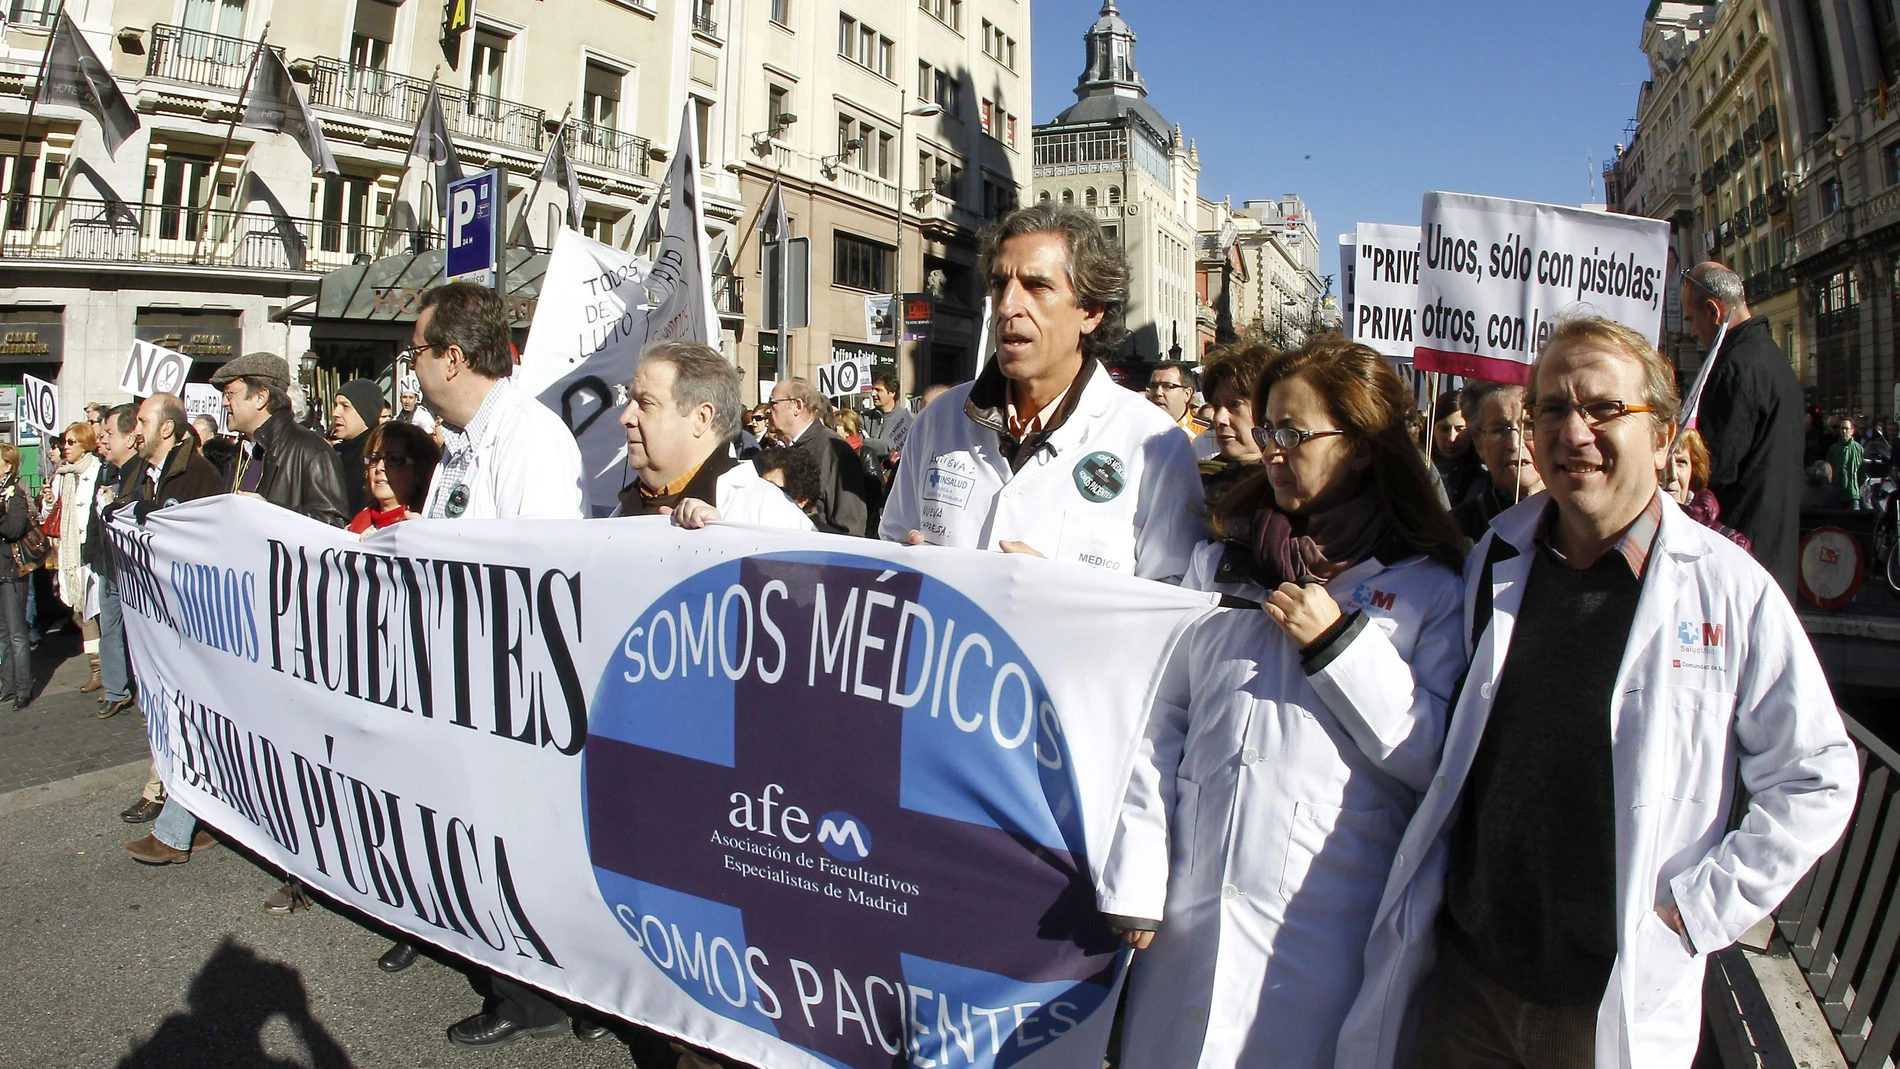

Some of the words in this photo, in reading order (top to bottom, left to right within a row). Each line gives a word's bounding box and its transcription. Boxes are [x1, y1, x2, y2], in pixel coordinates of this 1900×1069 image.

[453, 188, 476, 248] P
[583, 258, 638, 296] TODOS
[1426, 222, 1482, 284] Unos,
[1488, 232, 1532, 282] sólo
[1537, 249, 1574, 288] con
[1577, 246, 1661, 311] pistolas;
[579, 312, 632, 358] LUTO
[585, 301, 610, 324] DE
[1359, 304, 1417, 342] PRIVA
[1421, 296, 1480, 353] otros,
[1488, 311, 1525, 351] con
[122, 343, 185, 395] NO
[819, 361, 859, 395] NO
[24, 377, 56, 430] NO
[940, 476, 968, 490] INSALUD
[1079, 552, 1120, 571] MEDICO
[170, 560, 259, 663] somos
[267, 538, 588, 757] PACIENTES
[623, 579, 789, 684] SOMOS
[808, 570, 1064, 771] MÉDICOS
[1681, 661, 1709, 671] Comunidad
[172, 689, 299, 855] SANIDAD
[290, 735, 564, 970] PÚBLICA
[710, 829, 791, 864] Asociación
[795, 852, 814, 869] de
[819, 856, 920, 896] Facultativos
[724, 854, 819, 893] Especialistas
[824, 882, 843, 899] de
[847, 887, 908, 916] Madrid
[615, 902, 783, 1021] SOMOS
[789, 957, 1079, 1069] PACIENTES
